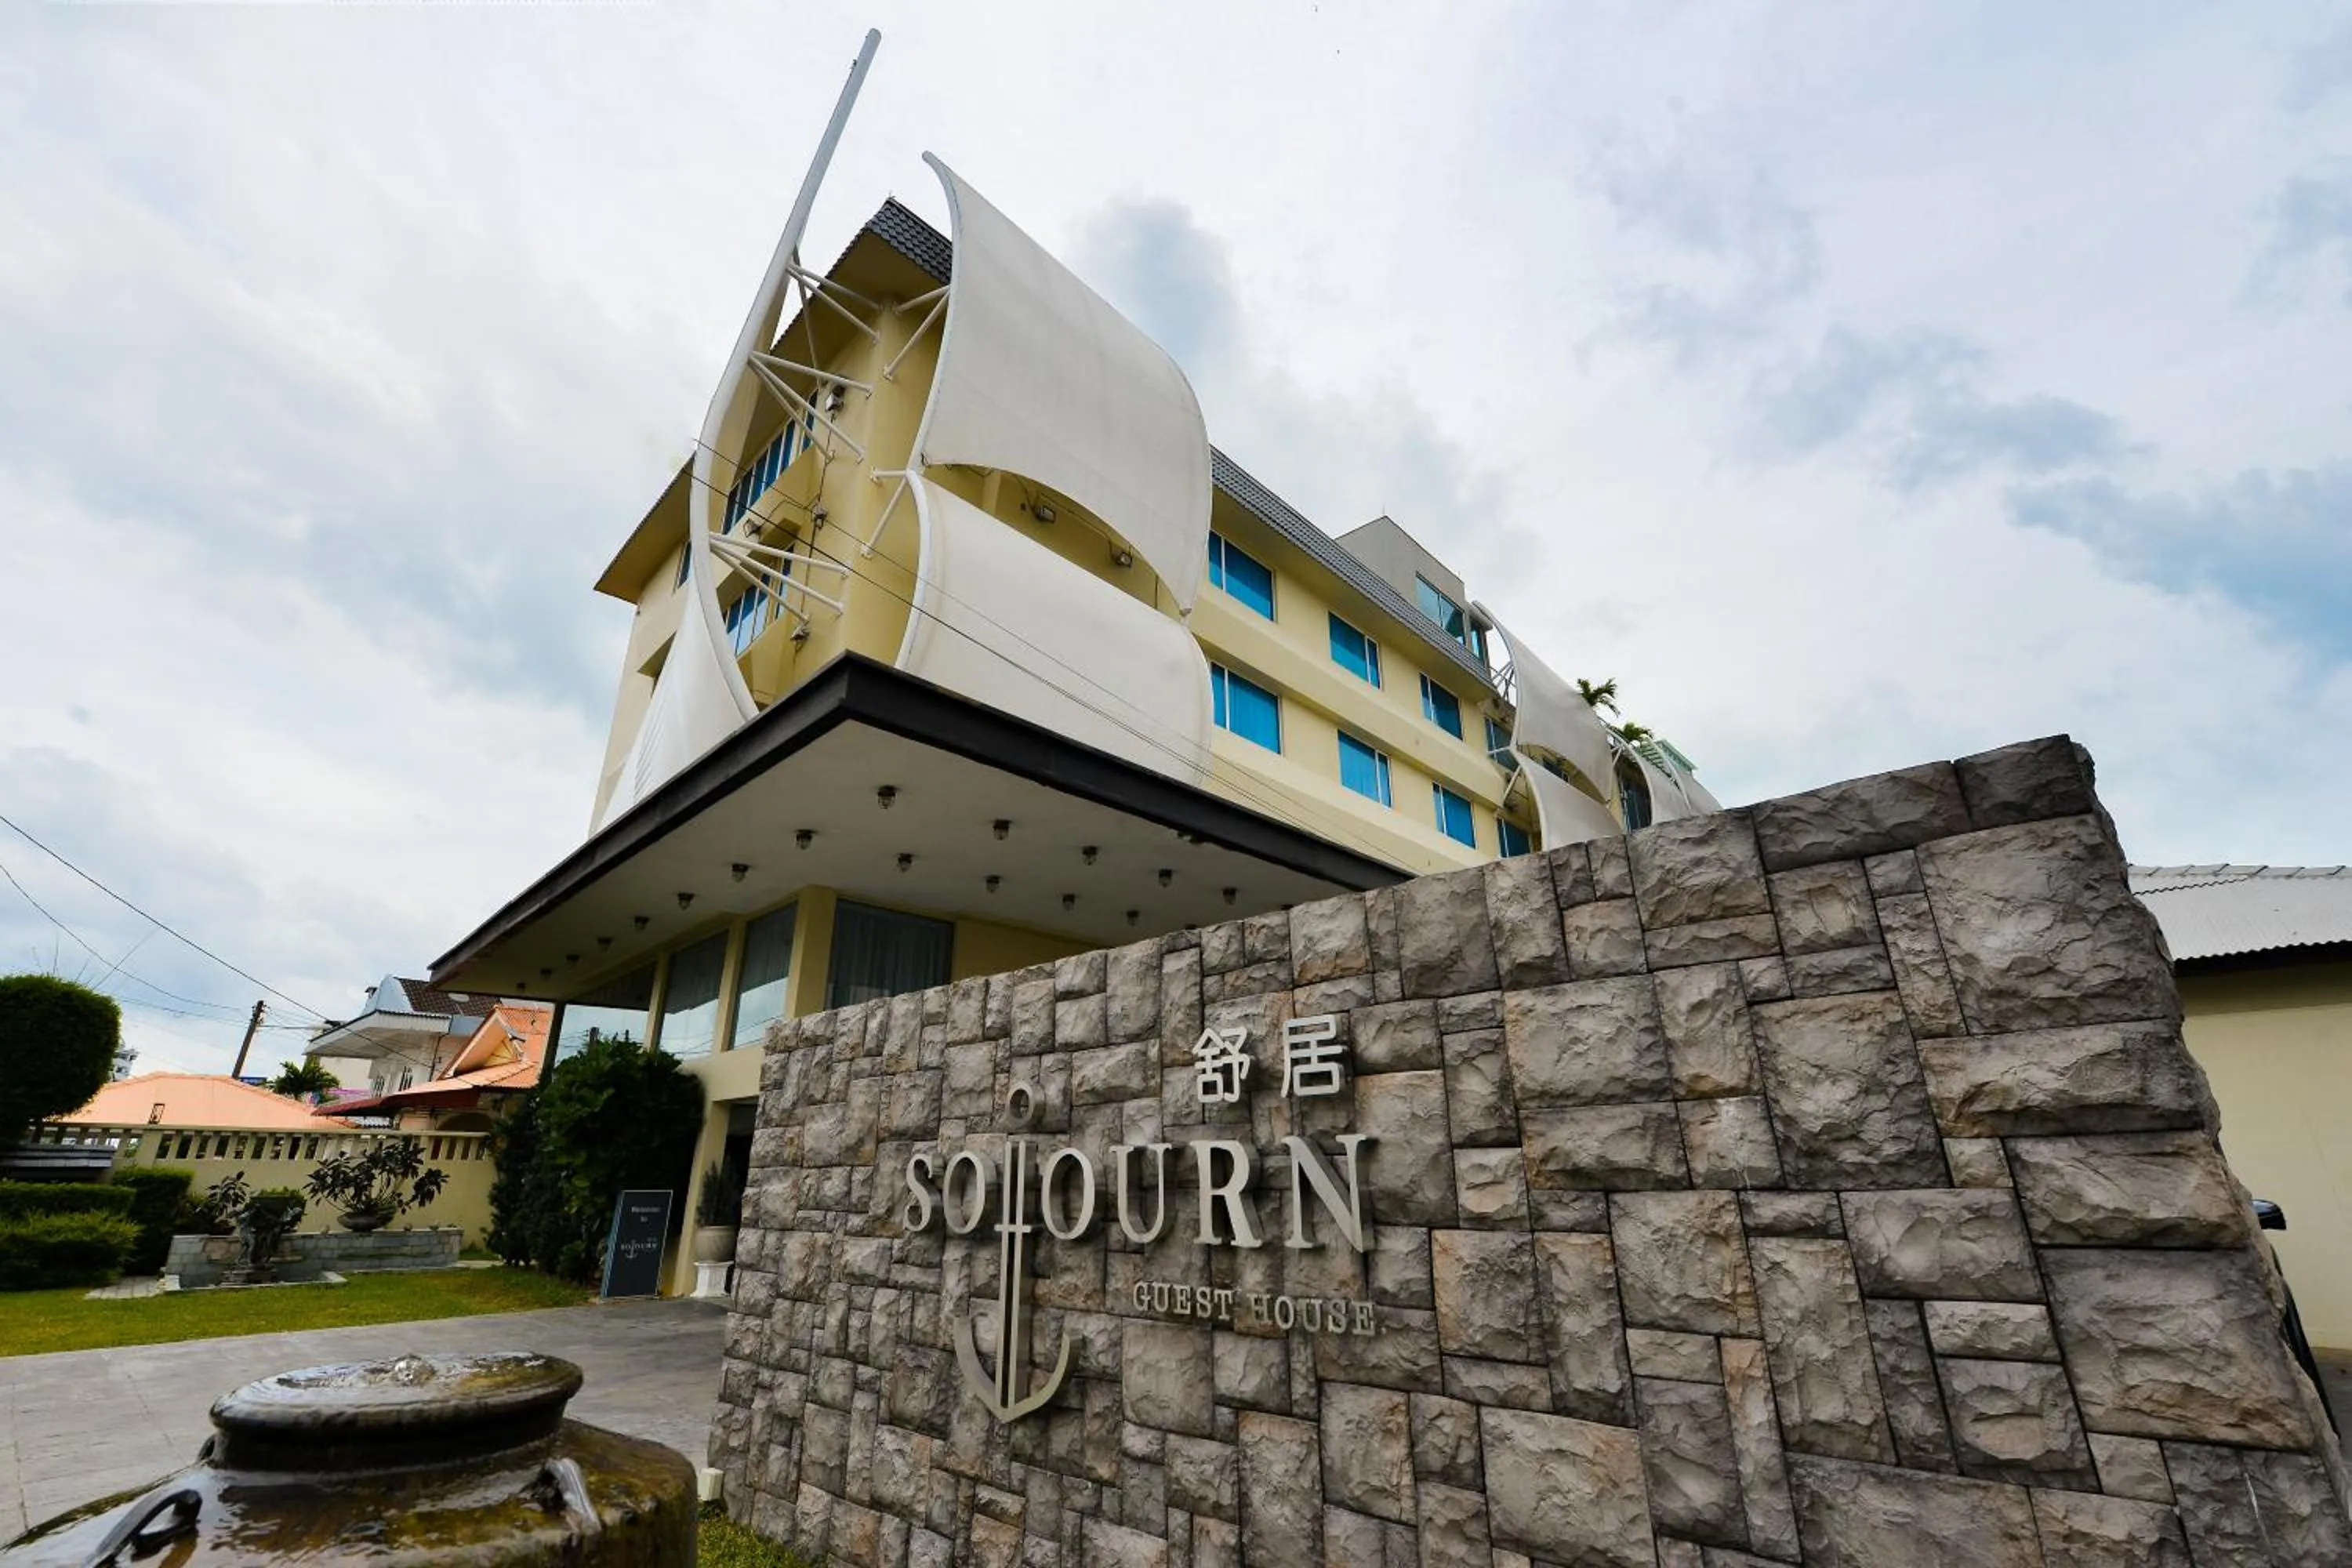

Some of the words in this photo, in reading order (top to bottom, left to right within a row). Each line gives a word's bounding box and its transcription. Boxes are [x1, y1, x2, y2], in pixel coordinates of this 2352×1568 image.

[1192, 1014, 1347, 1103] 舒居
[1133, 1281, 1233, 1320] GUEST
[1247, 1294, 1376, 1336] HOUSE
